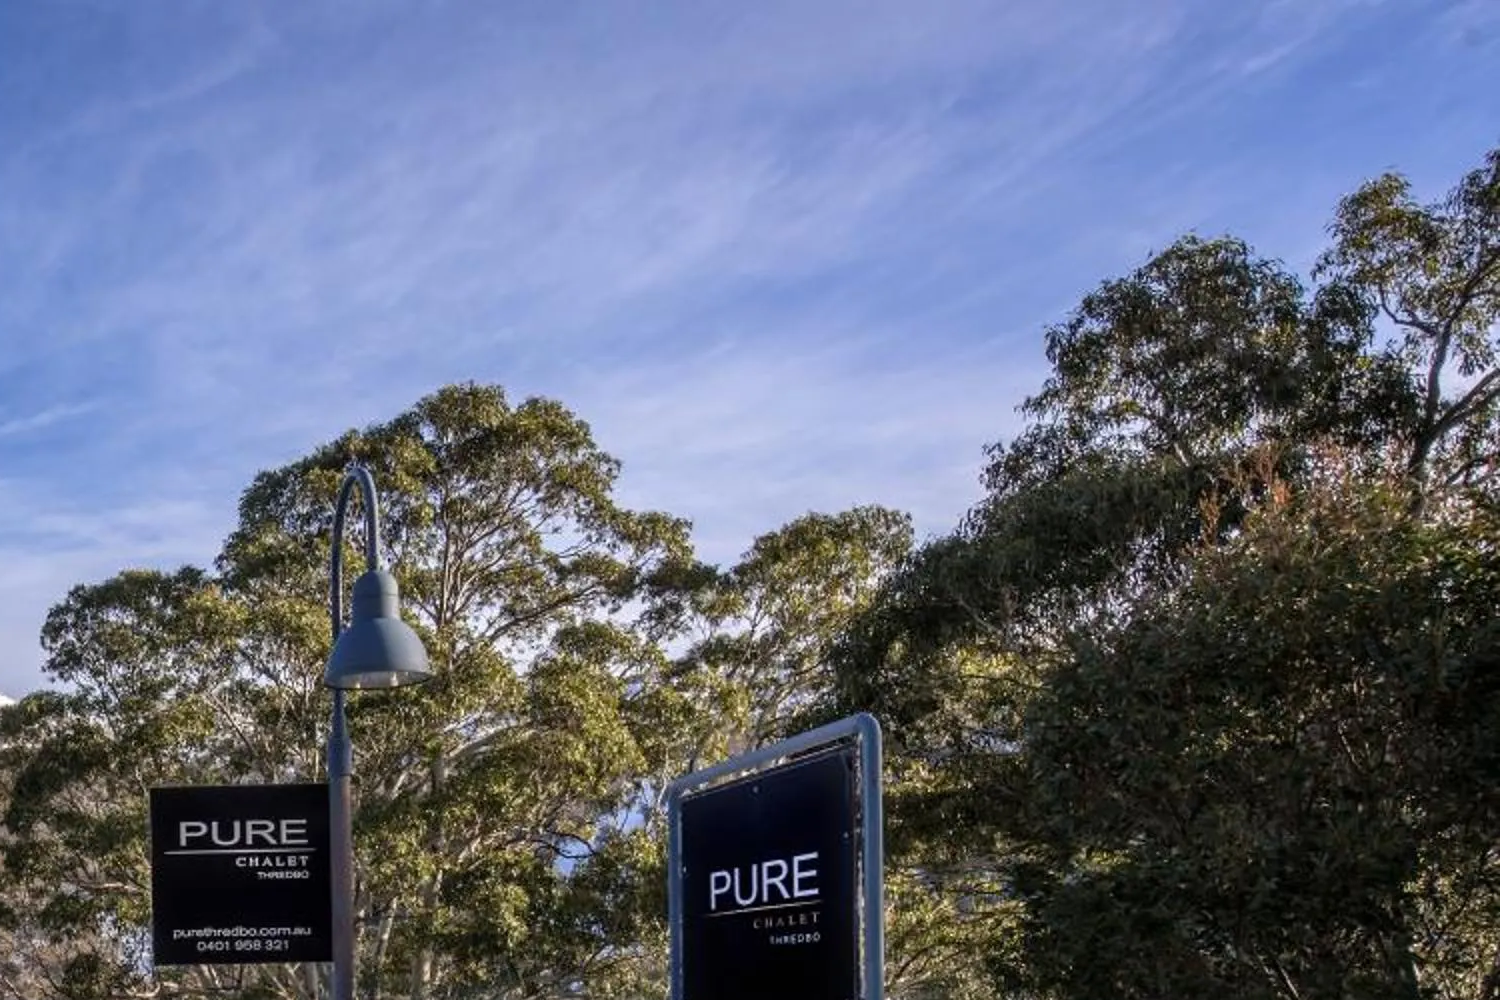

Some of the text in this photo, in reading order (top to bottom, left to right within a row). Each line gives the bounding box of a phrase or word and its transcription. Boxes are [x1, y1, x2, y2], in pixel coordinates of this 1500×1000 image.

[179, 819, 309, 847] PURE
[235, 855, 310, 868] CHALET
[256, 870, 310, 880] THREDBO
[709, 851, 820, 911] PURE
[752, 911, 821, 930] CHALET
[172, 925, 312, 940] purethredbo.com.au
[769, 931, 821, 945] THREDBO
[196, 940, 231, 952] 0401
[264, 939, 290, 951] 321
